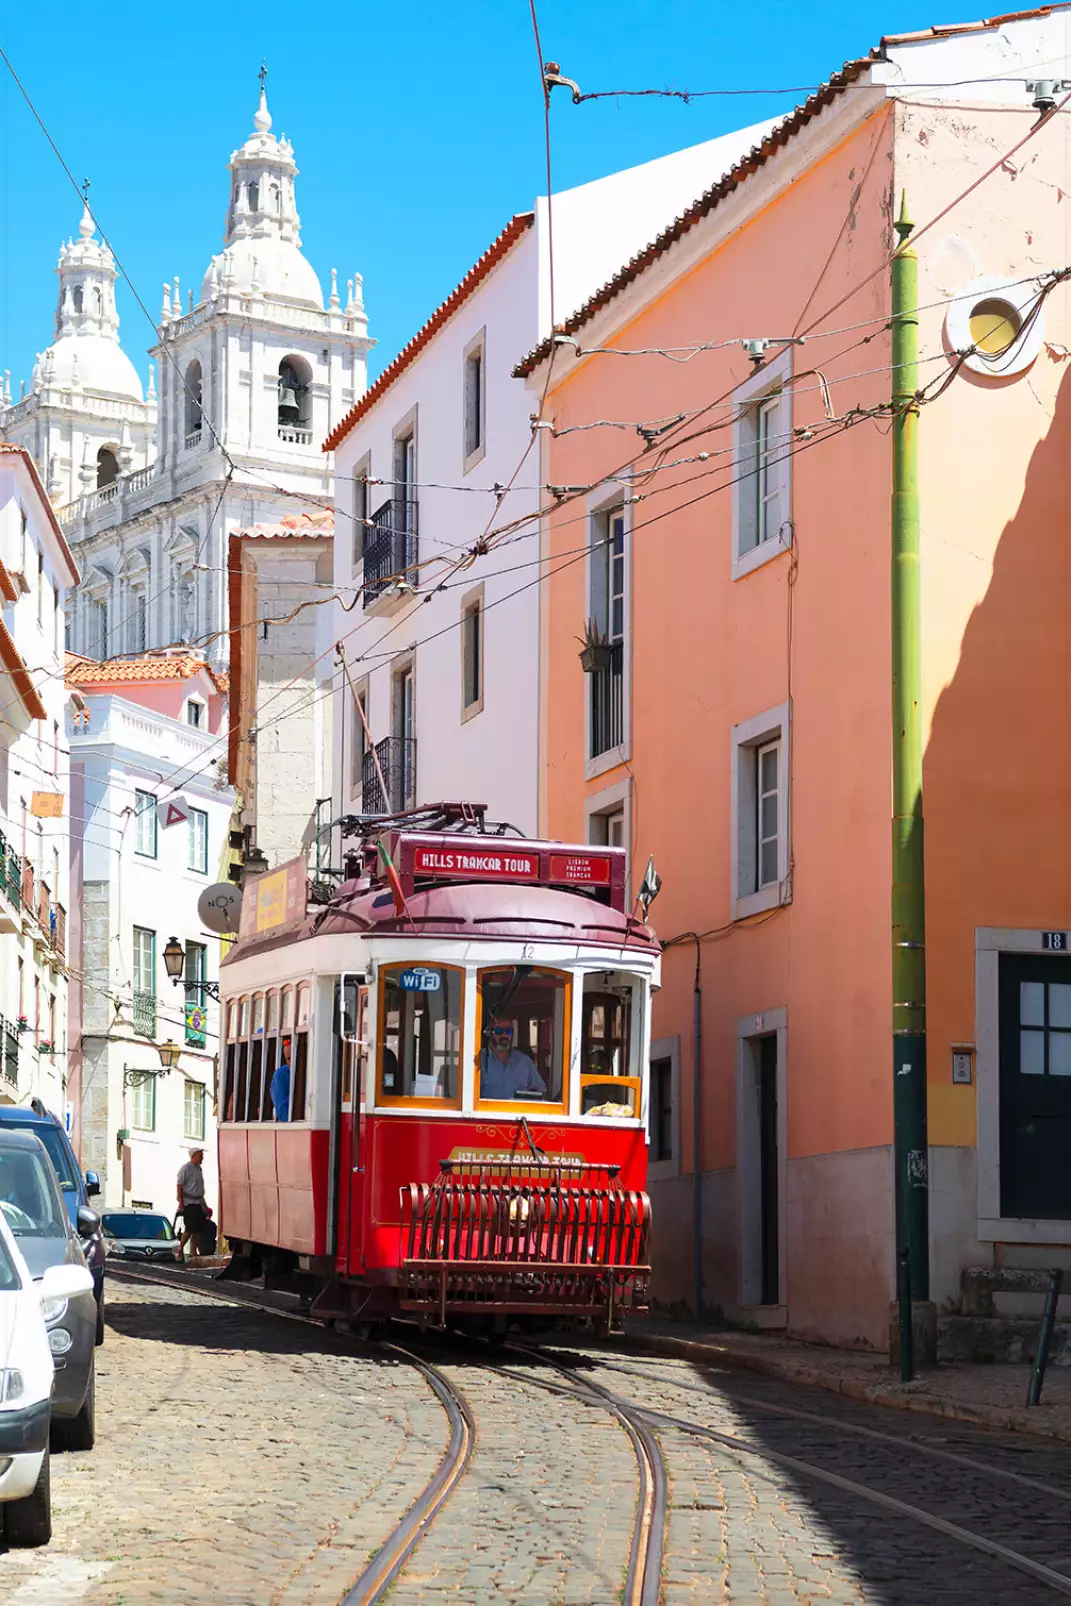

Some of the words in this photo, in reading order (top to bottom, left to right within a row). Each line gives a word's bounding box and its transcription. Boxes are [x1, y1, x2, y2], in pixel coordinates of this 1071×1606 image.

[422, 853, 454, 868] HILLS
[456, 855, 501, 871] TRAMCAR
[503, 858, 531, 873] TOUR
[1047, 933, 1062, 949] 18
[520, 945, 535, 959] 12
